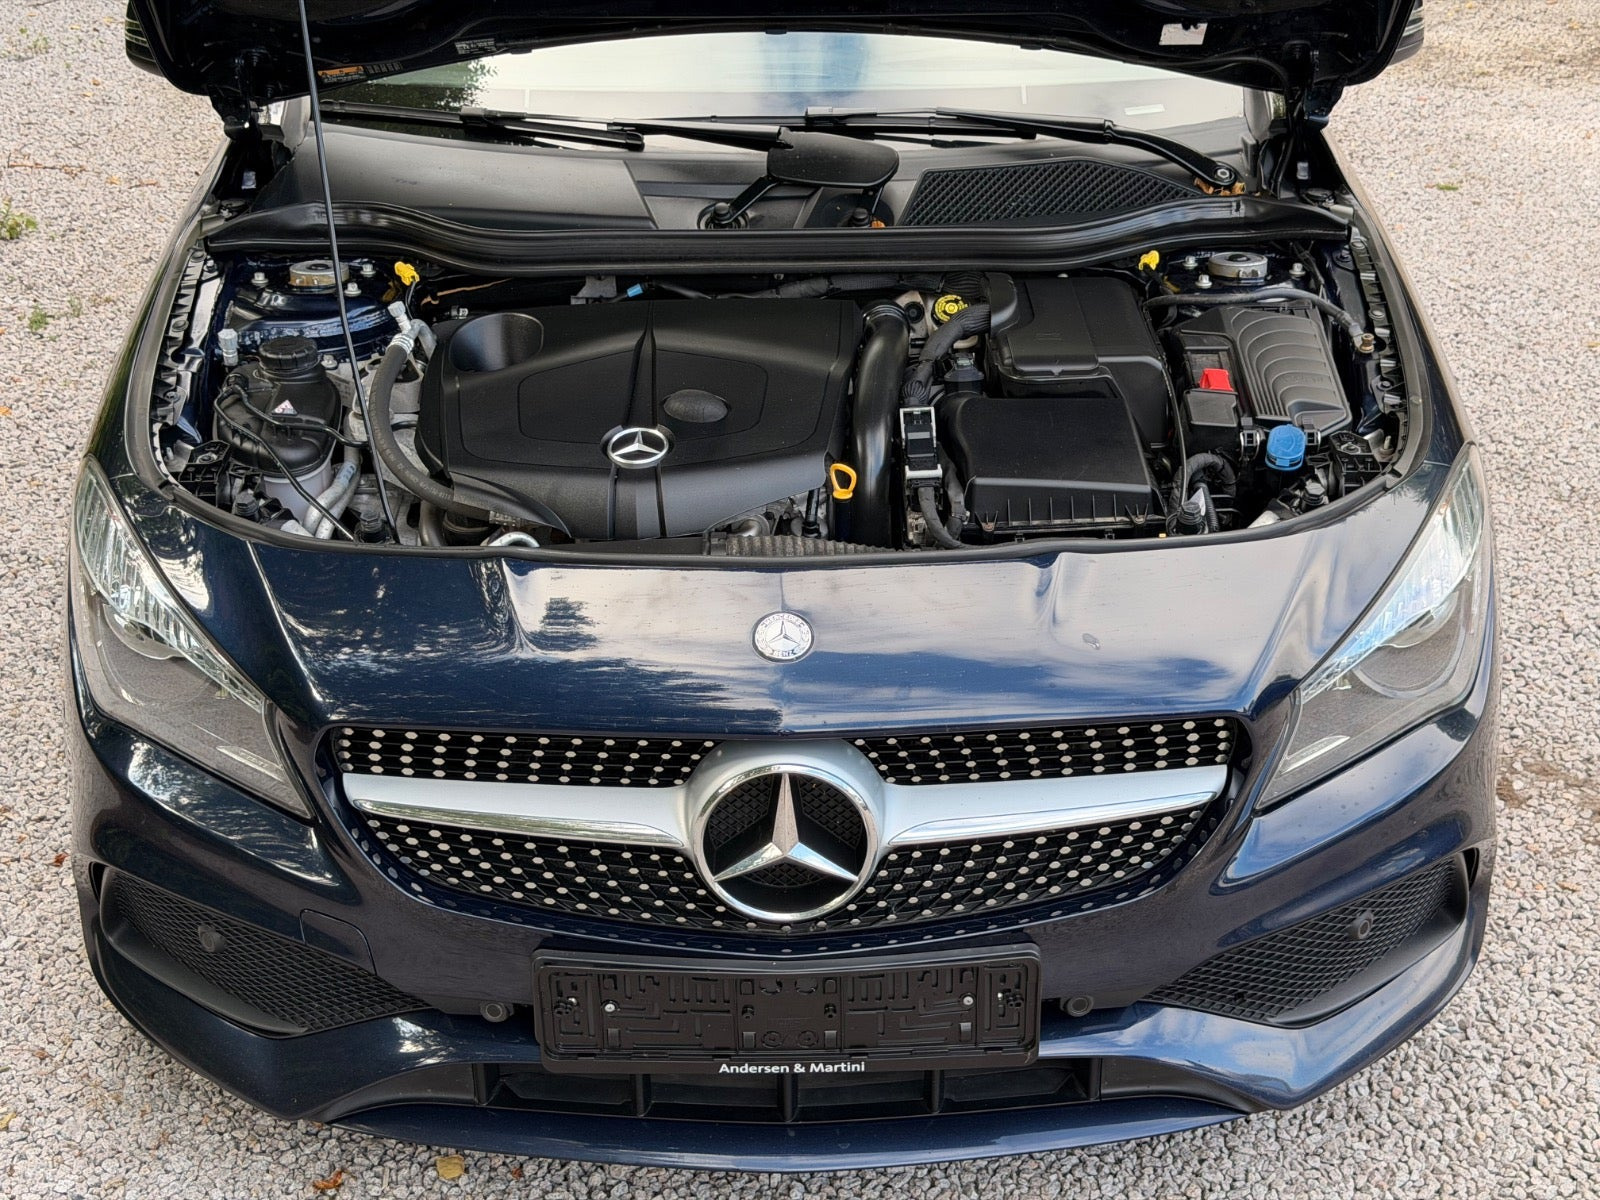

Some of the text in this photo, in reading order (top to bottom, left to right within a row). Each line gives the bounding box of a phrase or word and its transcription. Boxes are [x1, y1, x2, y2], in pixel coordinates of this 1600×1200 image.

[718, 1061, 865, 1074] Andersen & Martini
